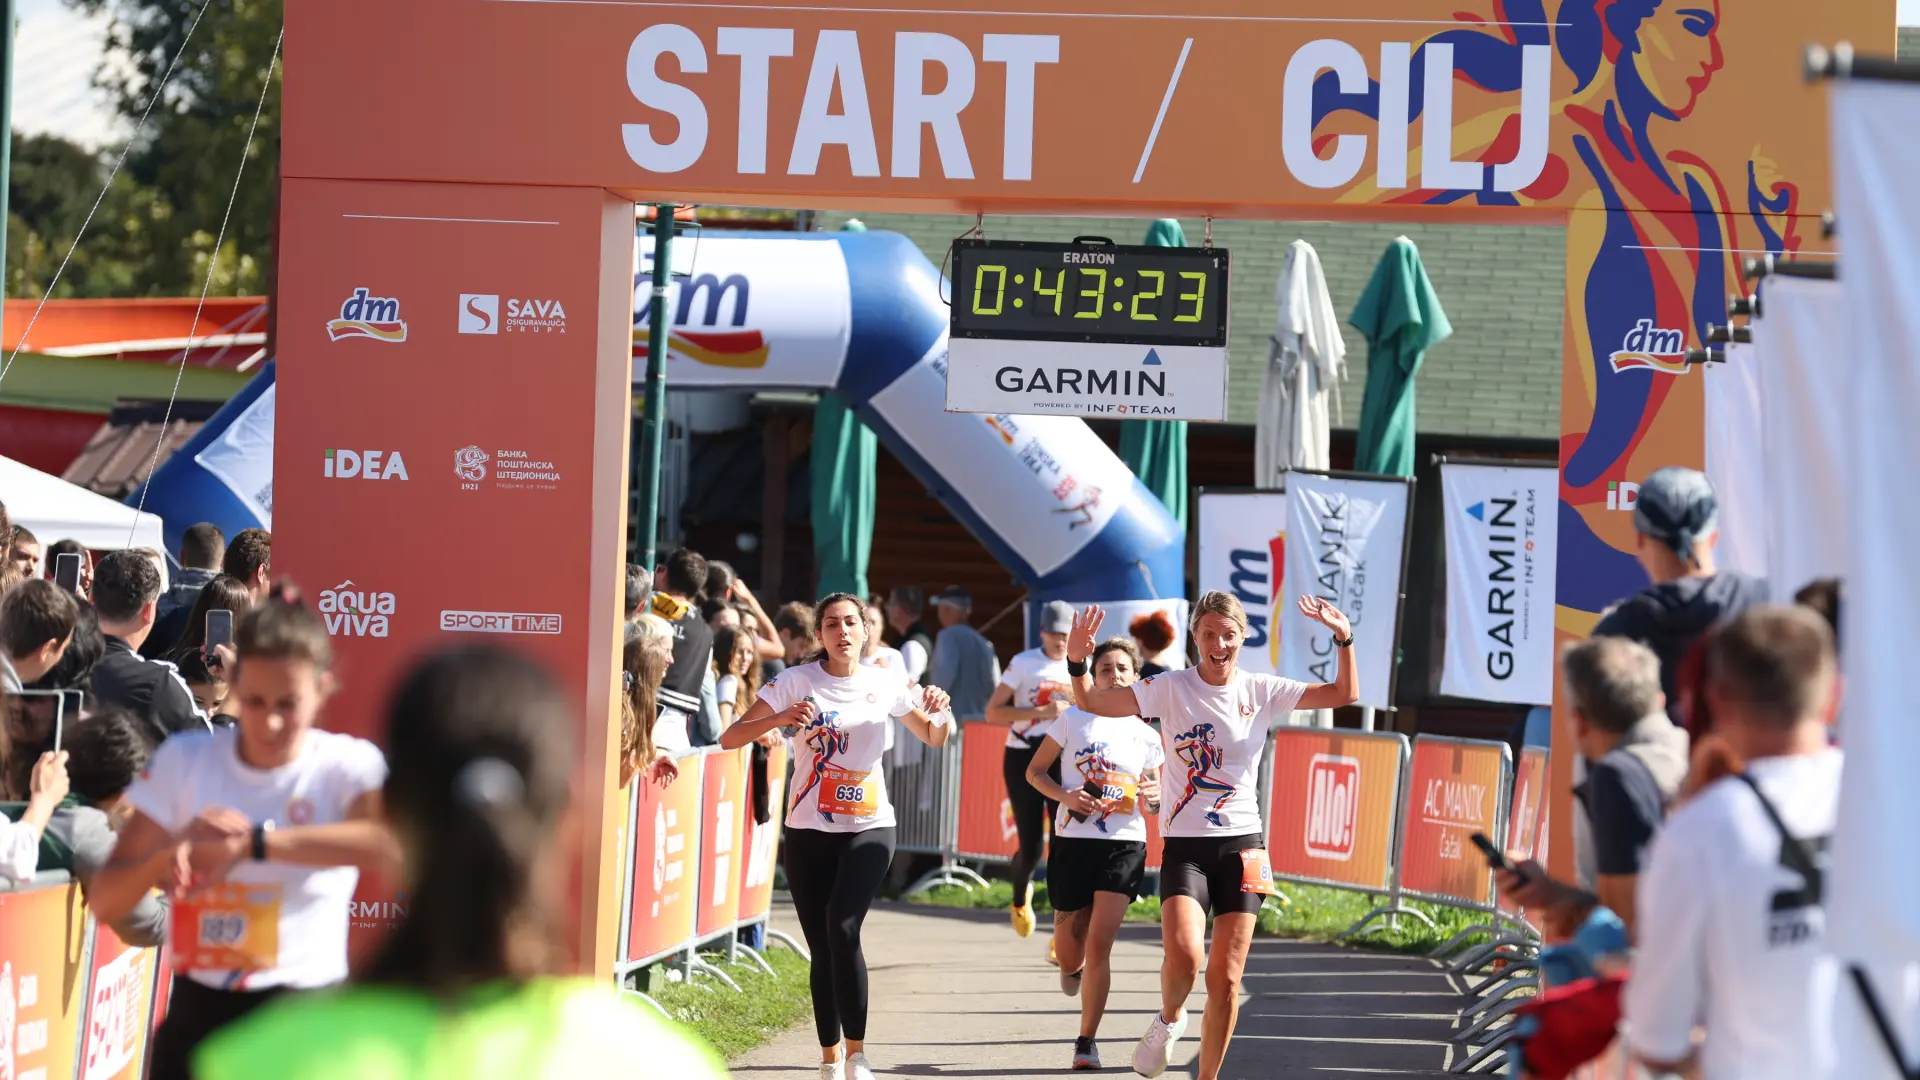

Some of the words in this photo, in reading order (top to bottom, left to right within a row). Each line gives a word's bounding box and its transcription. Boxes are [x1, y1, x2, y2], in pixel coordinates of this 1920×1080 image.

[622, 23, 1060, 181] START
[1282, 39, 1552, 192] CILJ
[1063, 252, 1115, 266] ERATON
[342, 289, 398, 322] dm
[972, 265, 1207, 323] 0:43:23
[507, 298, 566, 319] SAVA
[1625, 321, 1682, 354] dm
[995, 366, 1166, 397] GARMIN
[497, 449, 528, 459] БАНКА
[497, 460, 554, 470] ПОШТАНСКА
[461, 483, 479, 491] 1921
[496, 471, 561, 482] ШТЕДИОНИЦА
[1607, 481, 1640, 511] iD
[1487, 497, 1517, 680] GARMIN
[318, 589, 396, 615] aqua
[323, 612, 389, 637] viva
[1309, 635, 1334, 684] AC
[835, 785, 864, 802] 638
[1102, 784, 1125, 801] 142
[1423, 779, 1442, 817] AC
[1443, 781, 1486, 821] MANIK
[347, 901, 409, 919] RMIN
